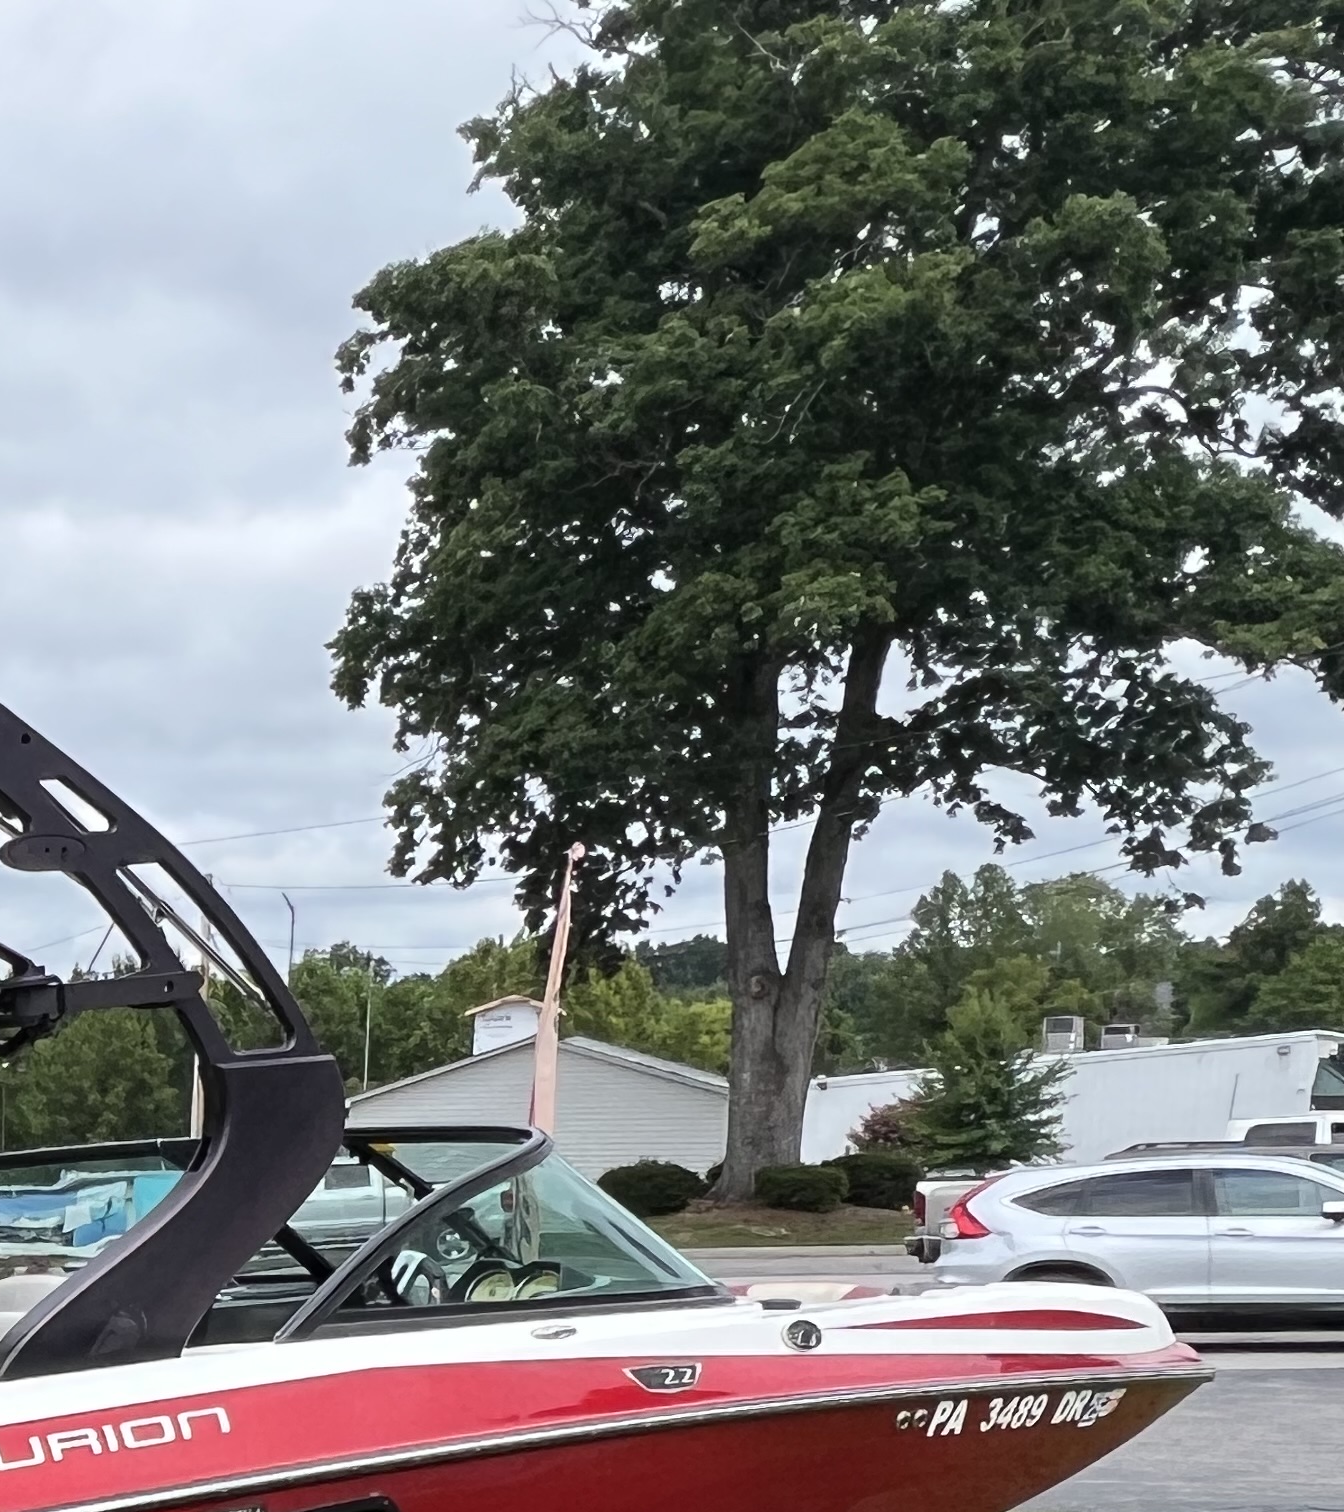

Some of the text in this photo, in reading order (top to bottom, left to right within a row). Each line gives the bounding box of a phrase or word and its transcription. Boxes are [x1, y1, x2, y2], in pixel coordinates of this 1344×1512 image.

[661, 1368, 693, 1385] 22
[926, 1400, 968, 1437] PA
[980, 1394, 1048, 1432] 3489
[1051, 1389, 1093, 1424] DR
